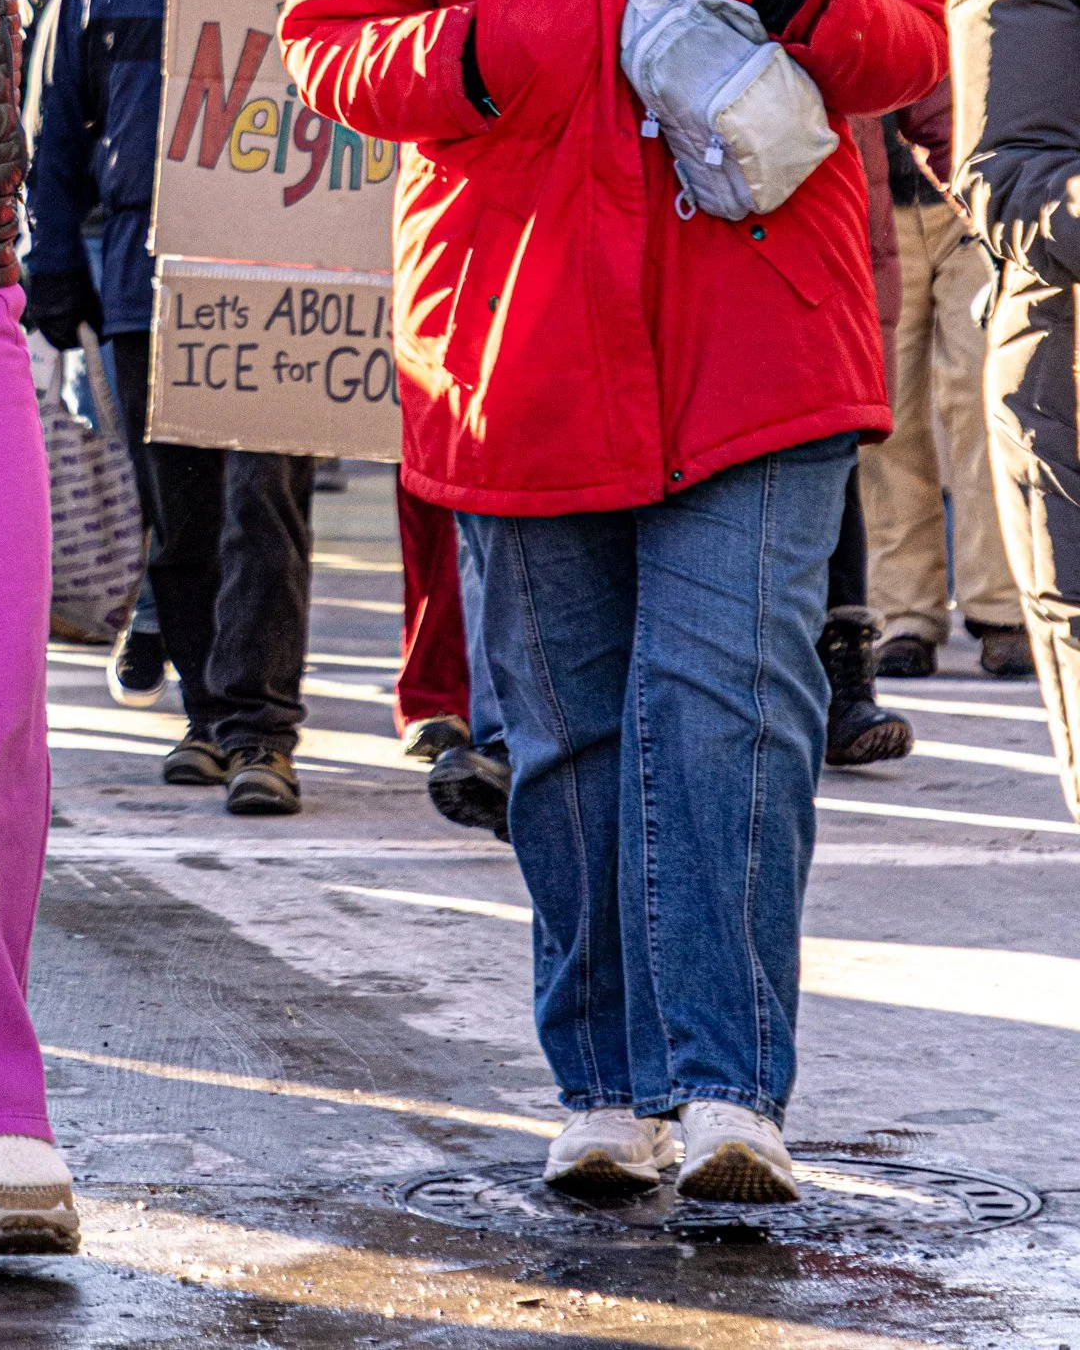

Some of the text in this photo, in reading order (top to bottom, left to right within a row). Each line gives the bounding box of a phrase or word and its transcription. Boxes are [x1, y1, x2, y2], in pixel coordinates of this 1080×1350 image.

[167, 21, 398, 207] Neigh
[175, 287, 393, 340] Let's ABOLI
[171, 342, 260, 392] ICE
[272, 350, 320, 385] for
